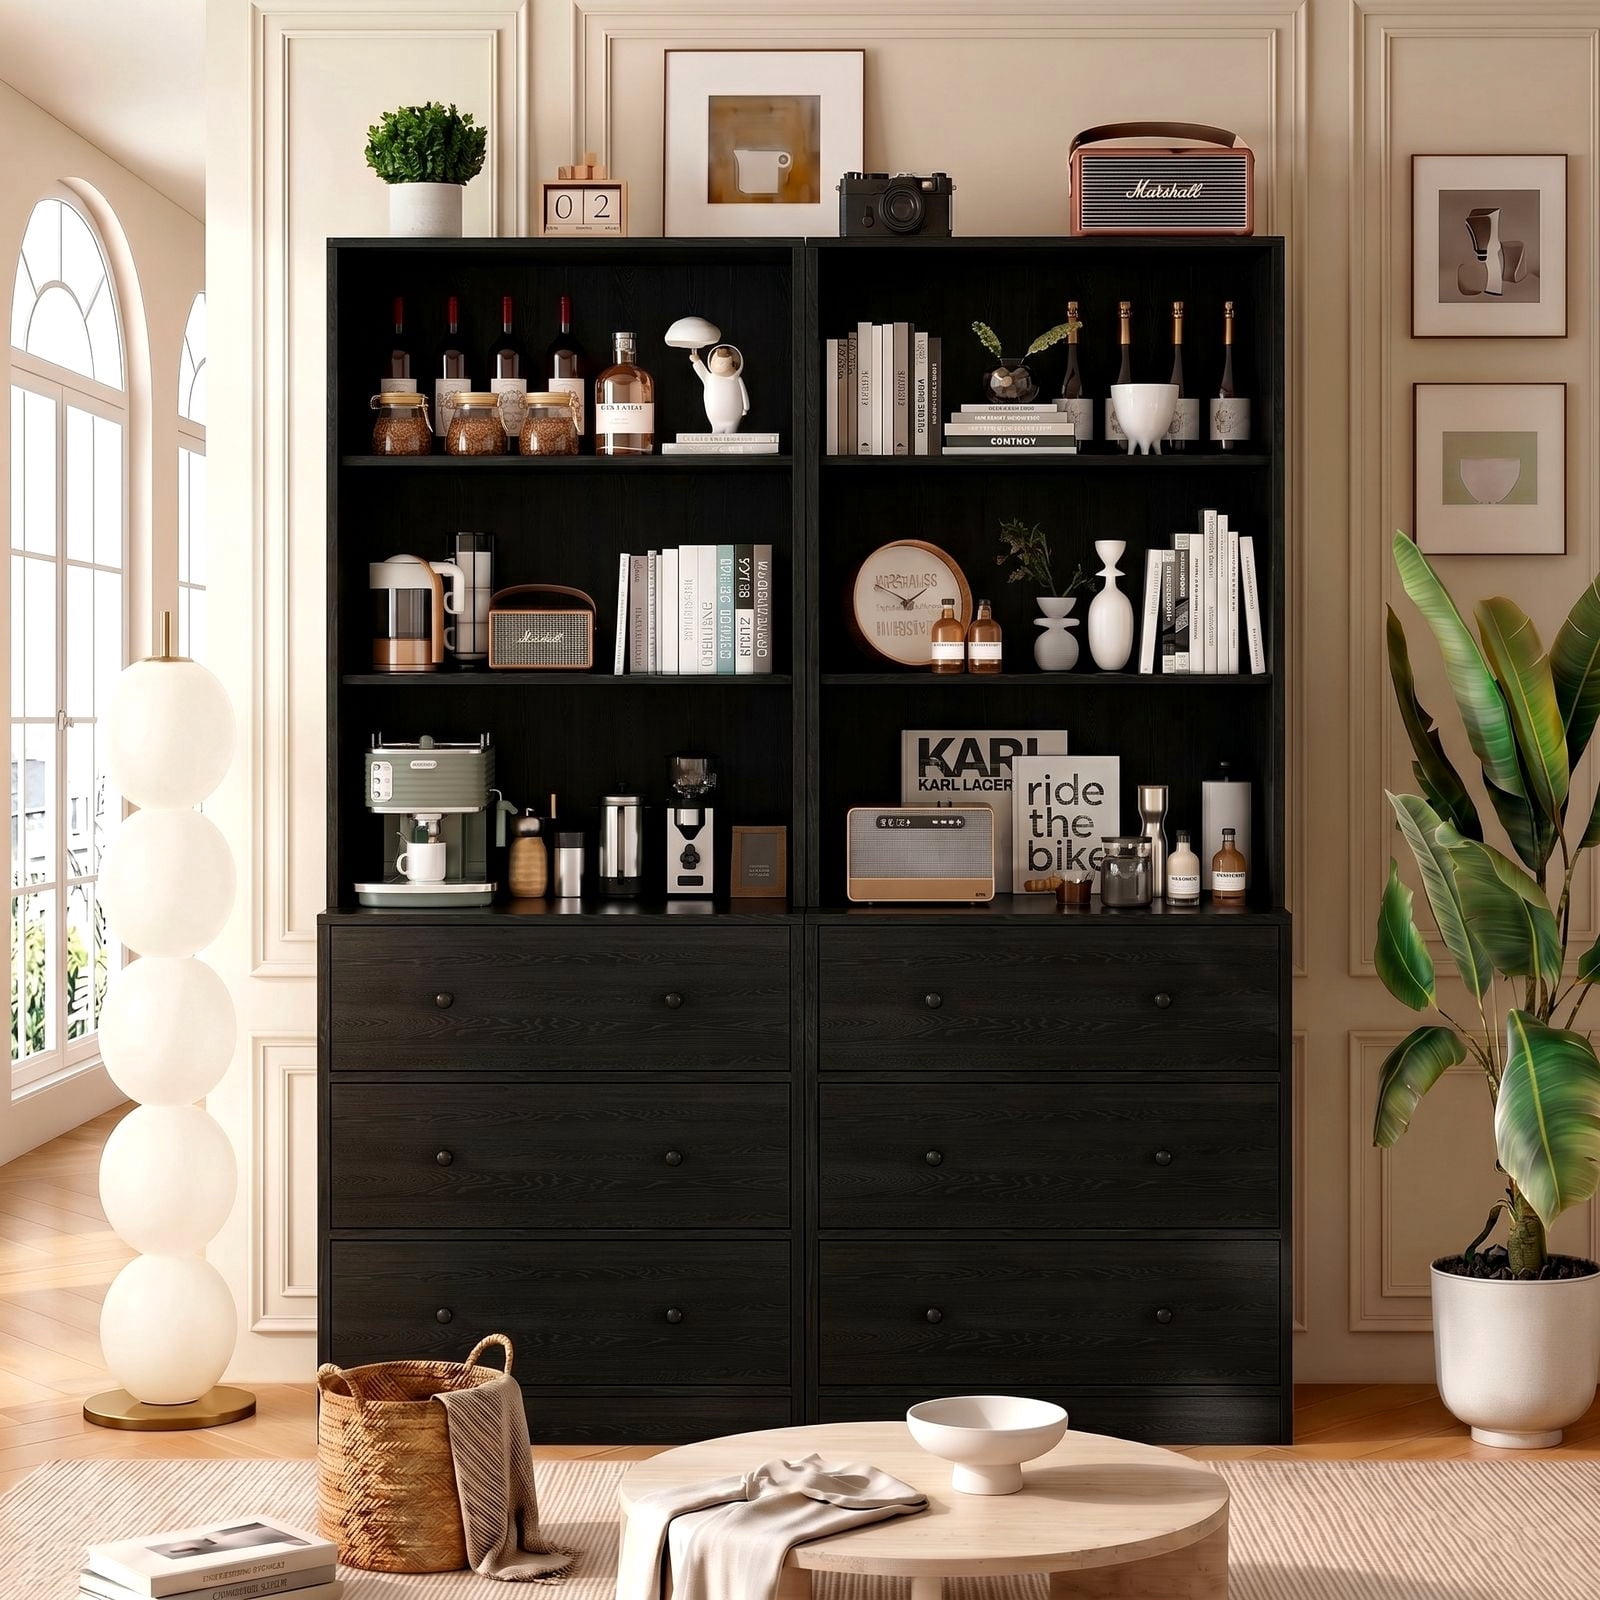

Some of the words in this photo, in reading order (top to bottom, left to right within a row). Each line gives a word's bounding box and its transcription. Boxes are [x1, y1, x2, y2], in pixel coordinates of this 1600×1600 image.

[1125, 178, 1204, 199] Marshall
[918, 778, 961, 791] KARL
[1028, 773, 1105, 806] ride
[1029, 806, 1094, 838] the
[1028, 839, 1105, 872] bike
